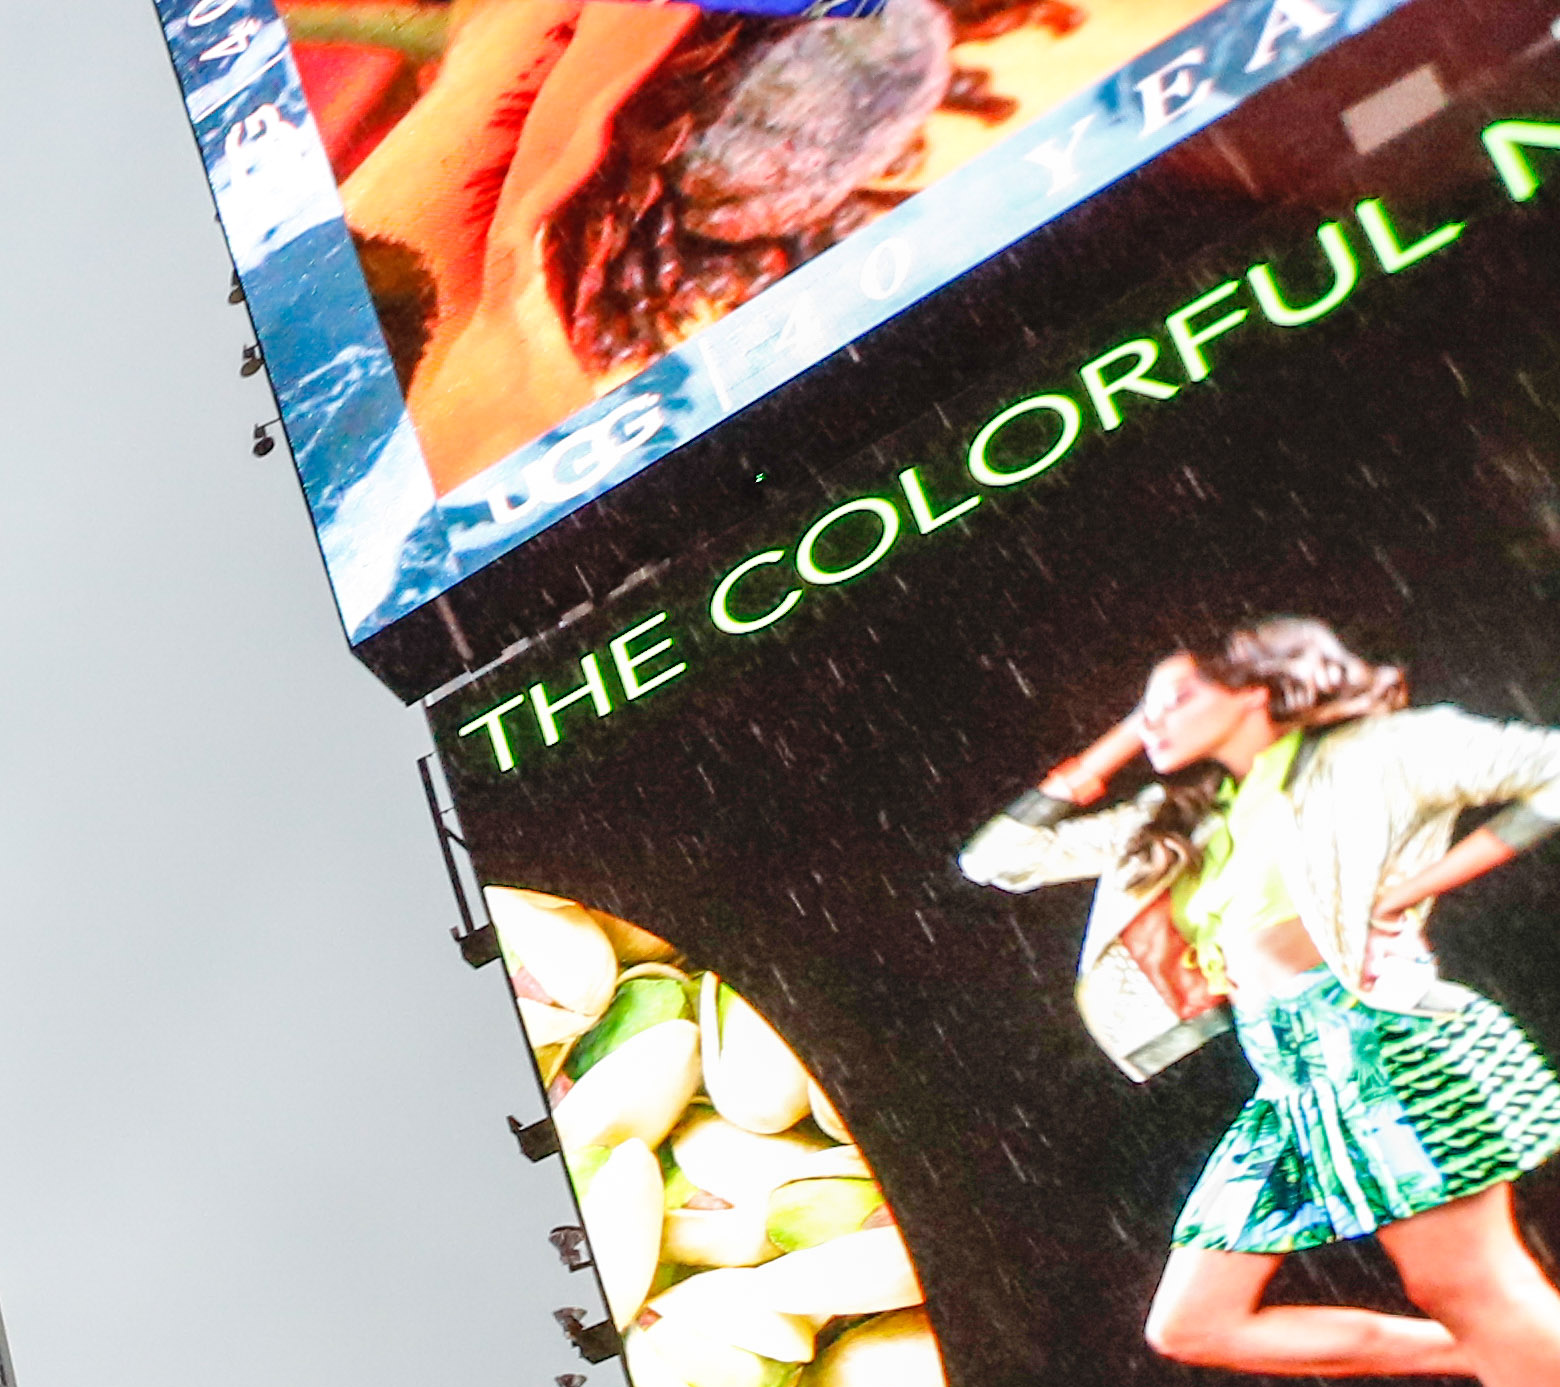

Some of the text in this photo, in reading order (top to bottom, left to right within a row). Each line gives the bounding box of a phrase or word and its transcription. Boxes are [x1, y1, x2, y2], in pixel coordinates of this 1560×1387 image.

[458, 197, 1467, 774] THE COLORFUL
[484, 390, 664, 526] UGG
